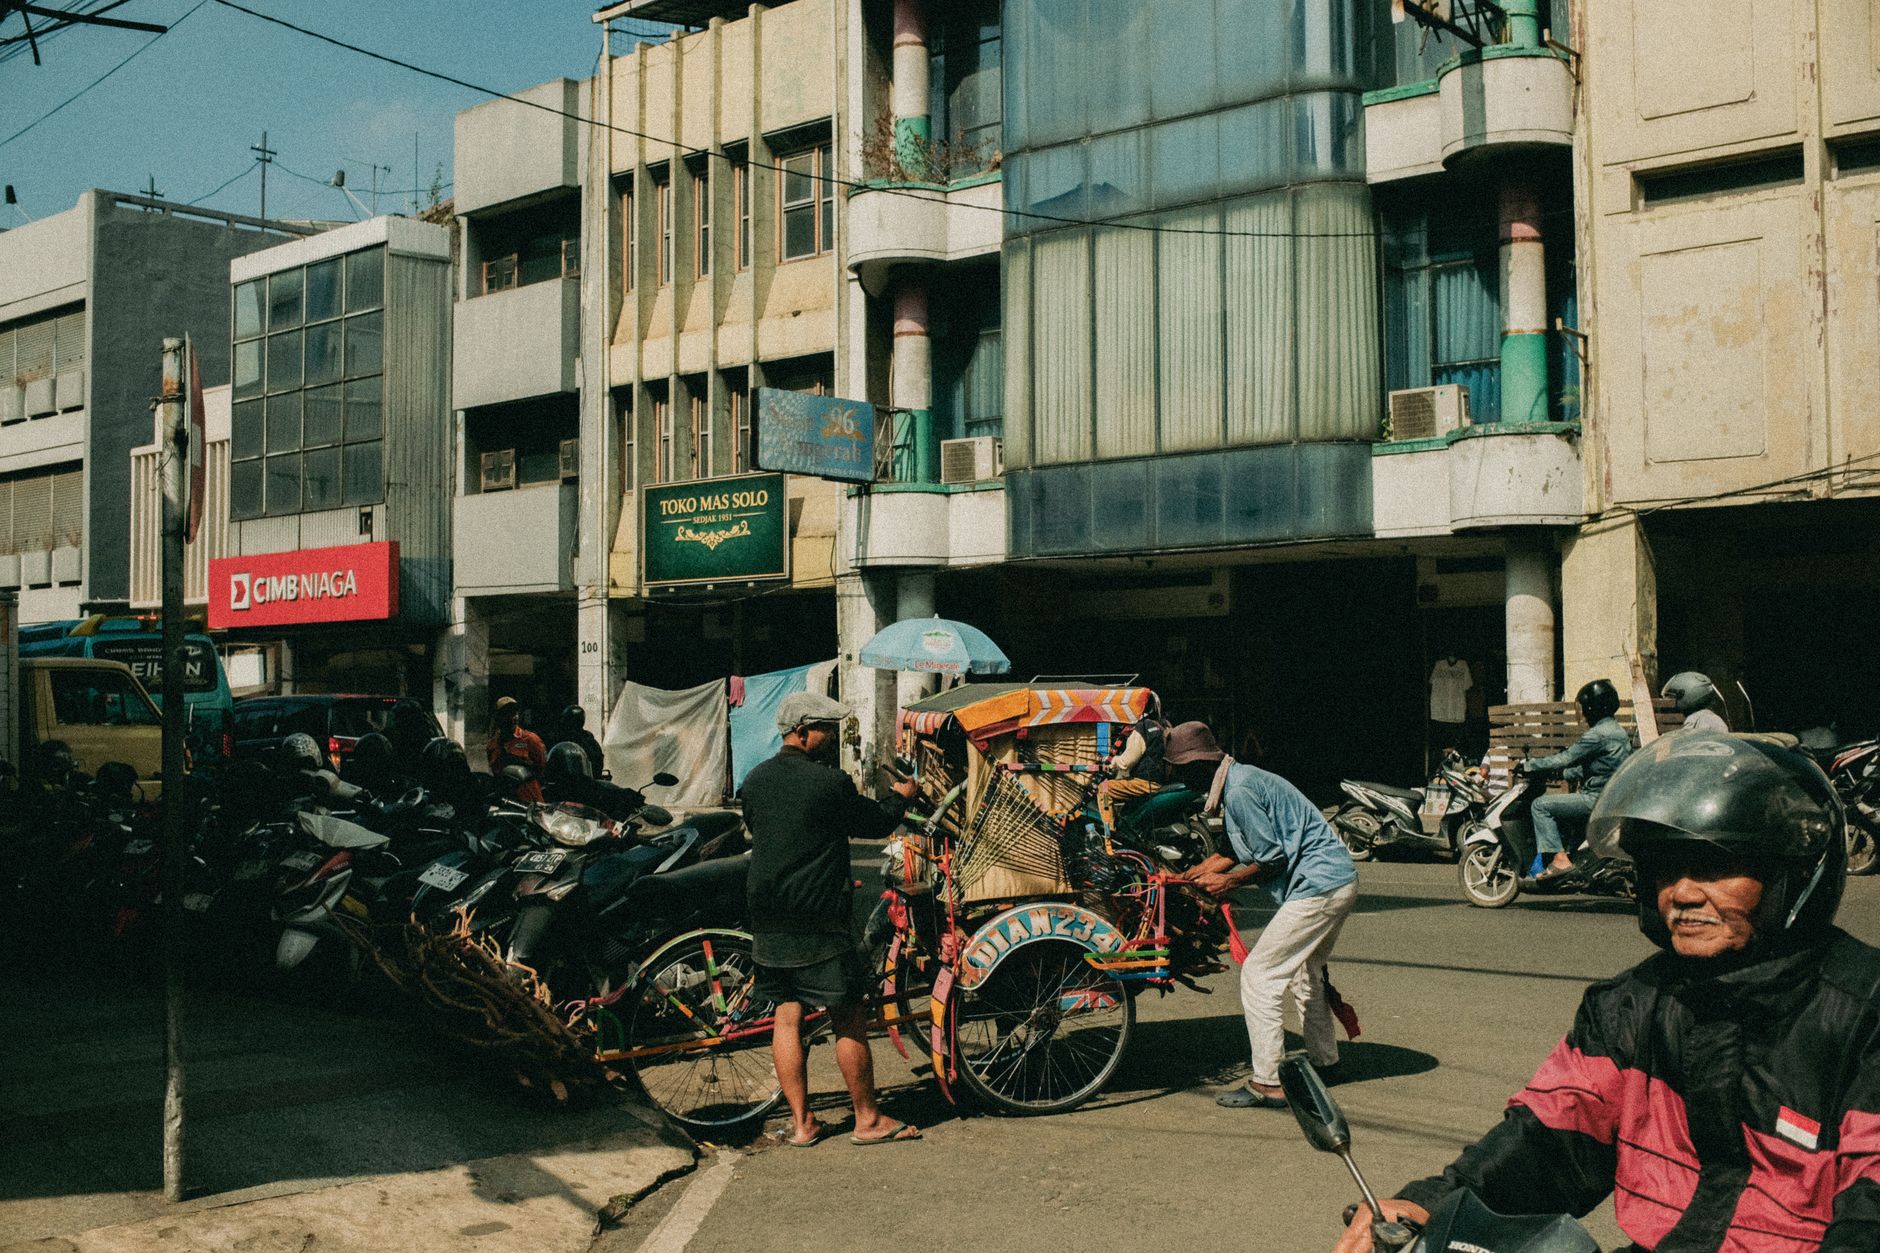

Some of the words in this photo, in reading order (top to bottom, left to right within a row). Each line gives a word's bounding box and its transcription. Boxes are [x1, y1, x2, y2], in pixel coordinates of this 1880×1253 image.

[660, 498, 697, 515] TOKO
[700, 494, 730, 512] MAS
[732, 490, 768, 509] SOLO
[581, 641, 598, 653] 100
